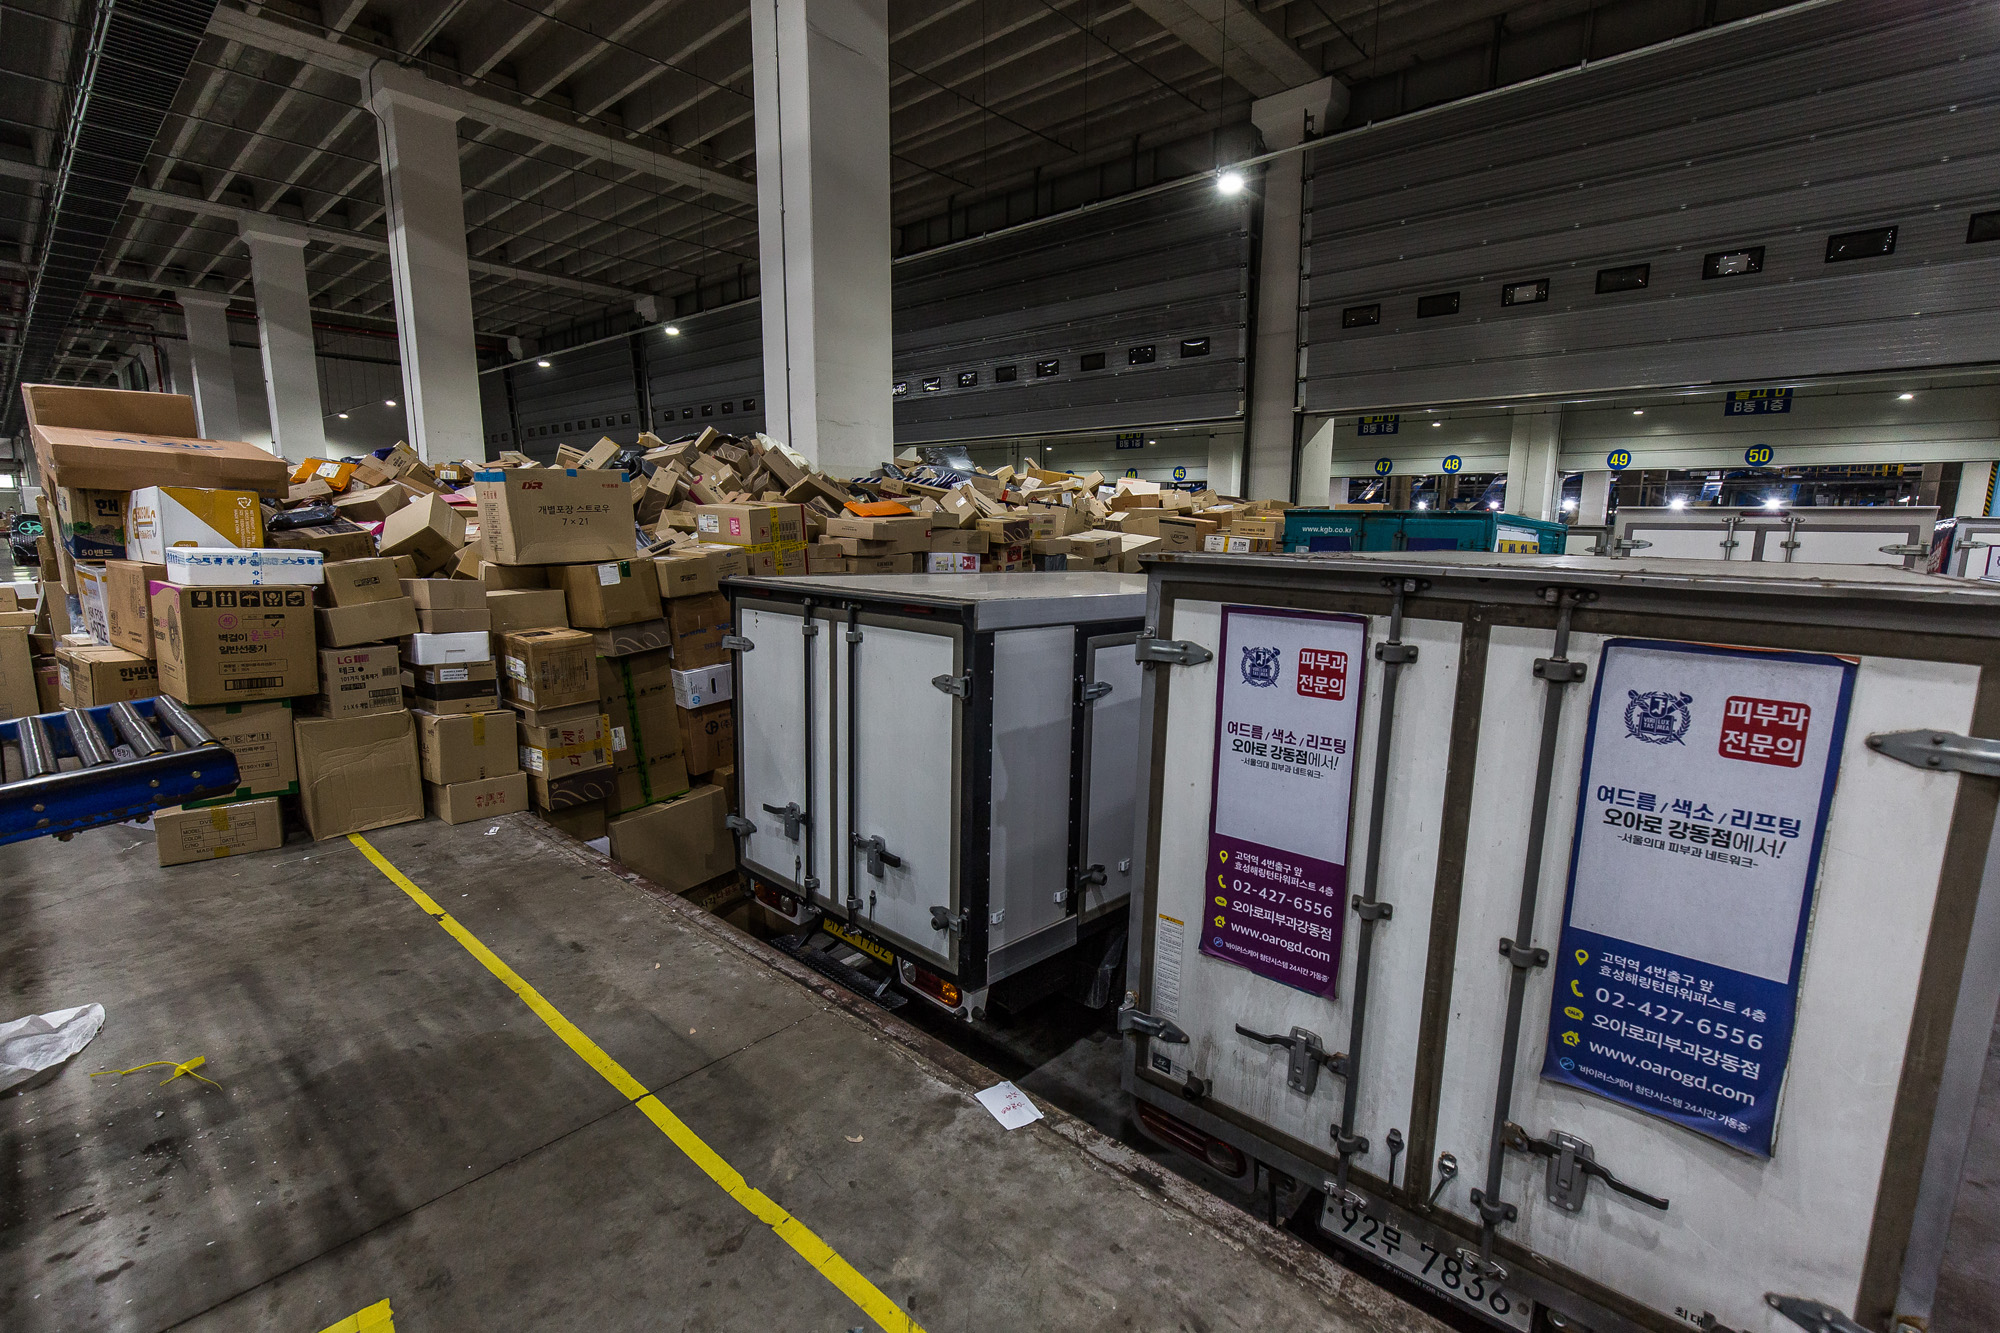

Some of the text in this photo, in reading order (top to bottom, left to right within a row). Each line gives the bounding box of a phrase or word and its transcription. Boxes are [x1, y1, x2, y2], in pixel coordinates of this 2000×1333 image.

[1733, 399, 1784, 413] B동 1층
[1363, 422, 1395, 434] B동 1층
[1376, 461, 1391, 472] 47
[1444, 457, 1460, 471] 48
[1610, 453, 1629, 468] 49
[1748, 448, 1770, 462] 50
[1174, 468, 1185, 479] 45
[537, 504, 611, 515] 개별포장 스트로우
[562, 518, 568, 526] 7
[578, 517, 589, 526] 21
[1301, 526, 1353, 535] www.kgb.co.kr
[81, 548, 114, 557] 50밴드
[218, 633, 248, 643] 벽걸이
[219, 644, 267, 655] 일반선풍기
[337, 655, 352, 665] LG
[339, 666, 356, 675] 테크
[1300, 649, 1347, 673] 피부과
[1299, 674, 1344, 697] 전문의
[1726, 699, 1809, 732] 피부과
[1231, 738, 1340, 771] 오아로 강동점에서!
[1722, 729, 1802, 763] 전문의
[1271, 761, 1291, 774] 피부과
[1602, 807, 1787, 859] 오아로 강동점에서!
[196, 846, 214, 854] MADE
[1617, 834, 1759, 869] -서울의대 피부과 네트워크-
[1235, 850, 1303, 877] 고덕역 4번출구 앞
[1234, 861, 1334, 898] 효성해링턴타워퍼스트 4층
[1232, 879, 1333, 919] 02-427-6556
[1231, 900, 1333, 942] 오아로피부과강동점
[1230, 922, 1331, 962] www.oarogd.com
[1259, 953, 1288, 970] 첨단시스템
[1289, 963, 1309, 976] 24시간
[1600, 951, 1715, 994] 고덕역 4번출구 앞
[1598, 964, 1768, 1023] 효성해링턴타워퍼스트 4층
[1595, 987, 1764, 1051] 02-427-6556
[1591, 1013, 1761, 1081] 오아로피부과강동점
[1588, 1040, 1756, 1107] www.oarogd.com
[1635, 1084, 1683, 1109] 첨단시스템
[1683, 1102, 1718, 1121] 24시간
[1340, 1205, 1511, 1317] 92무 7836
[1674, 1304, 1704, 1328] 최대
